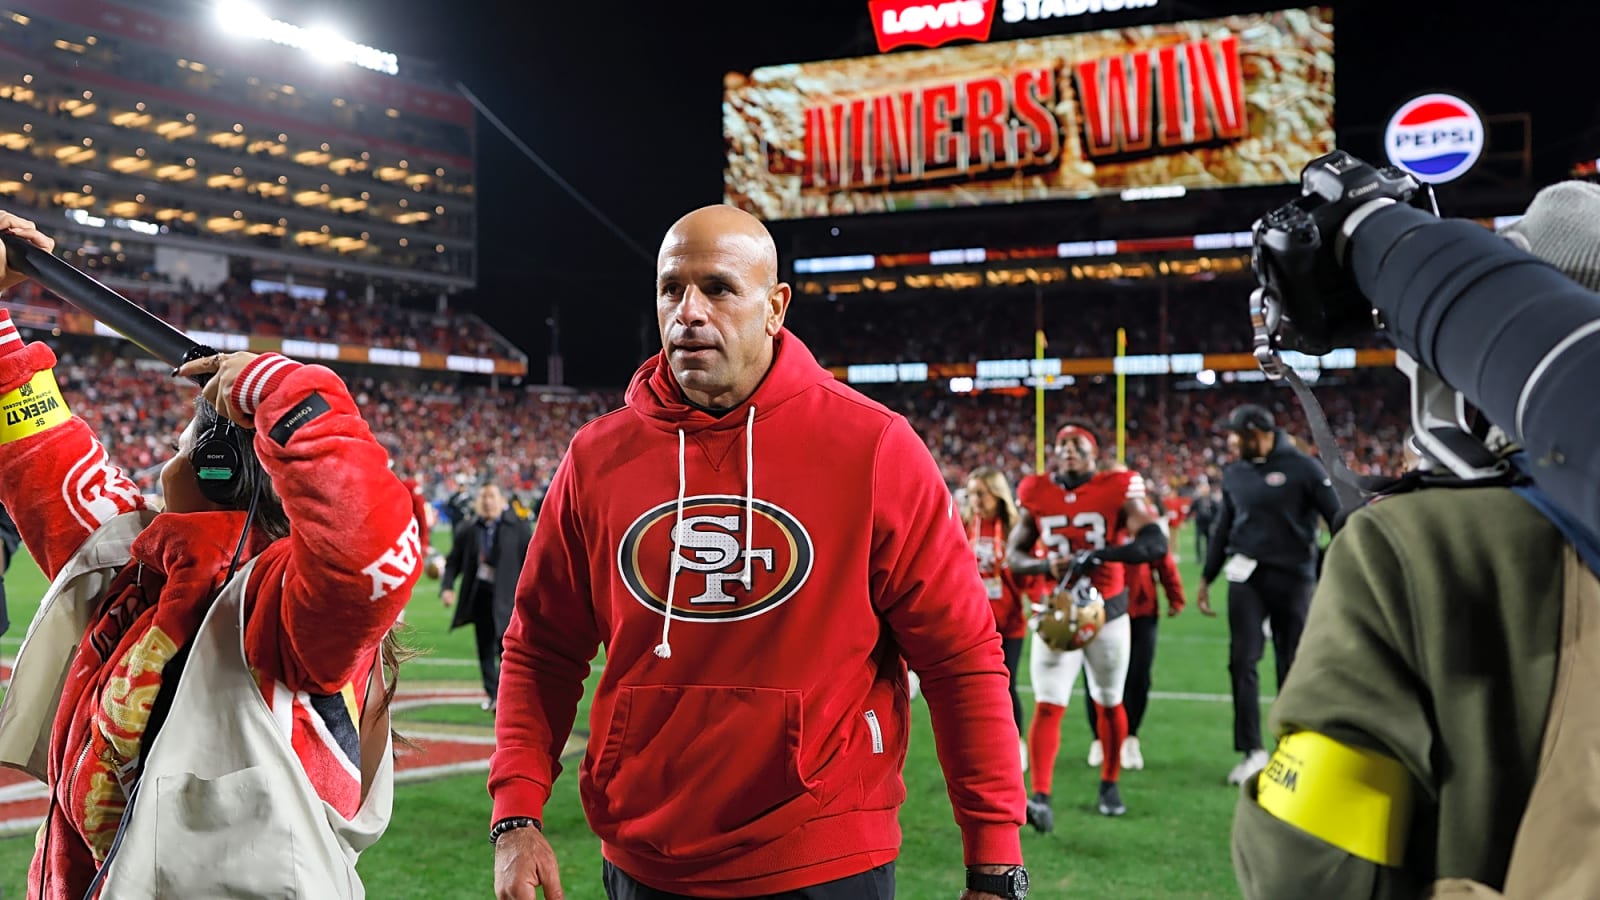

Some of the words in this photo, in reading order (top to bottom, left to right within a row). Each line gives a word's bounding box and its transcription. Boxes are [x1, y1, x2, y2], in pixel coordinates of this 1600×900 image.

[803, 68, 1059, 188] NINERS
[1076, 36, 1247, 154] WIN
[1396, 129, 1474, 147] PEPSI
[1348, 181, 1379, 198] Canon
[6, 410, 22, 426] 17
[18, 396, 59, 421] WEEK
[1039, 511, 1107, 557] 53
